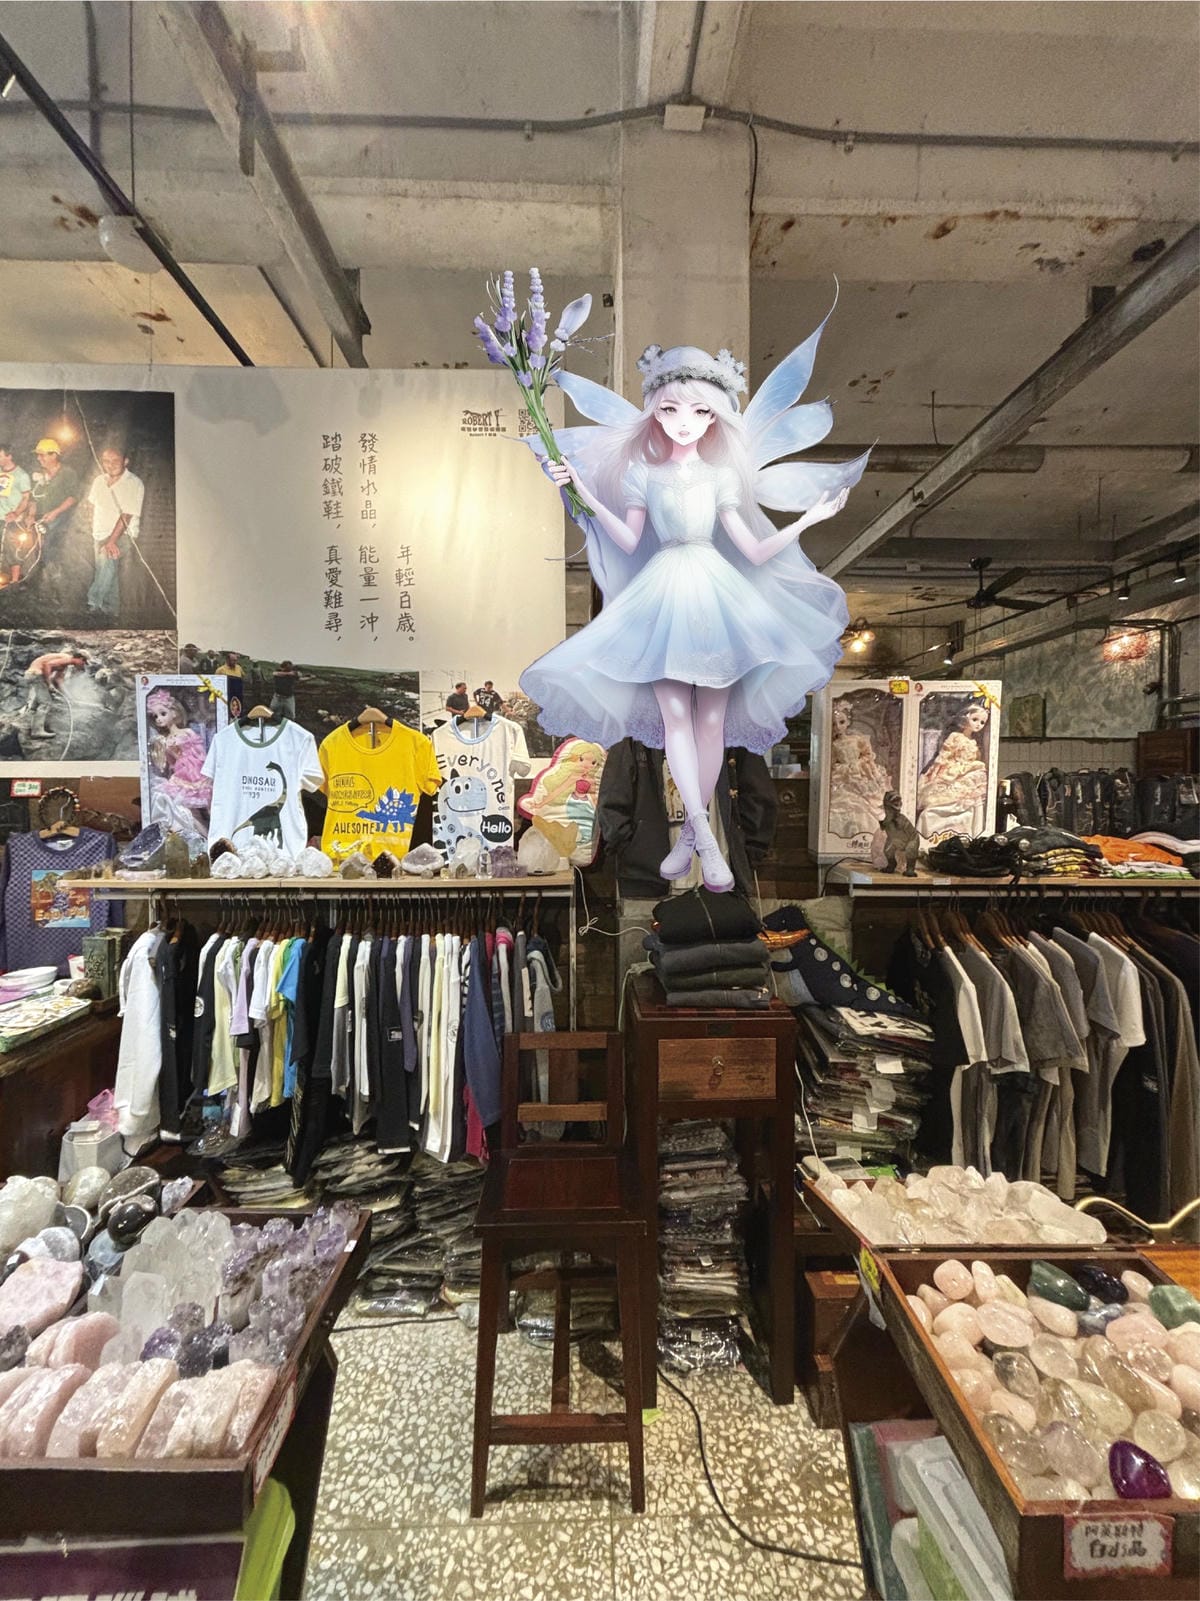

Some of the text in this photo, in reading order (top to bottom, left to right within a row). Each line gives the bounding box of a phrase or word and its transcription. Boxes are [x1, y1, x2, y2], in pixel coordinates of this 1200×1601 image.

[435, 753, 505, 804] Everyone
[333, 822, 375, 834] AWESOME
[482, 820, 511, 833] Hello
